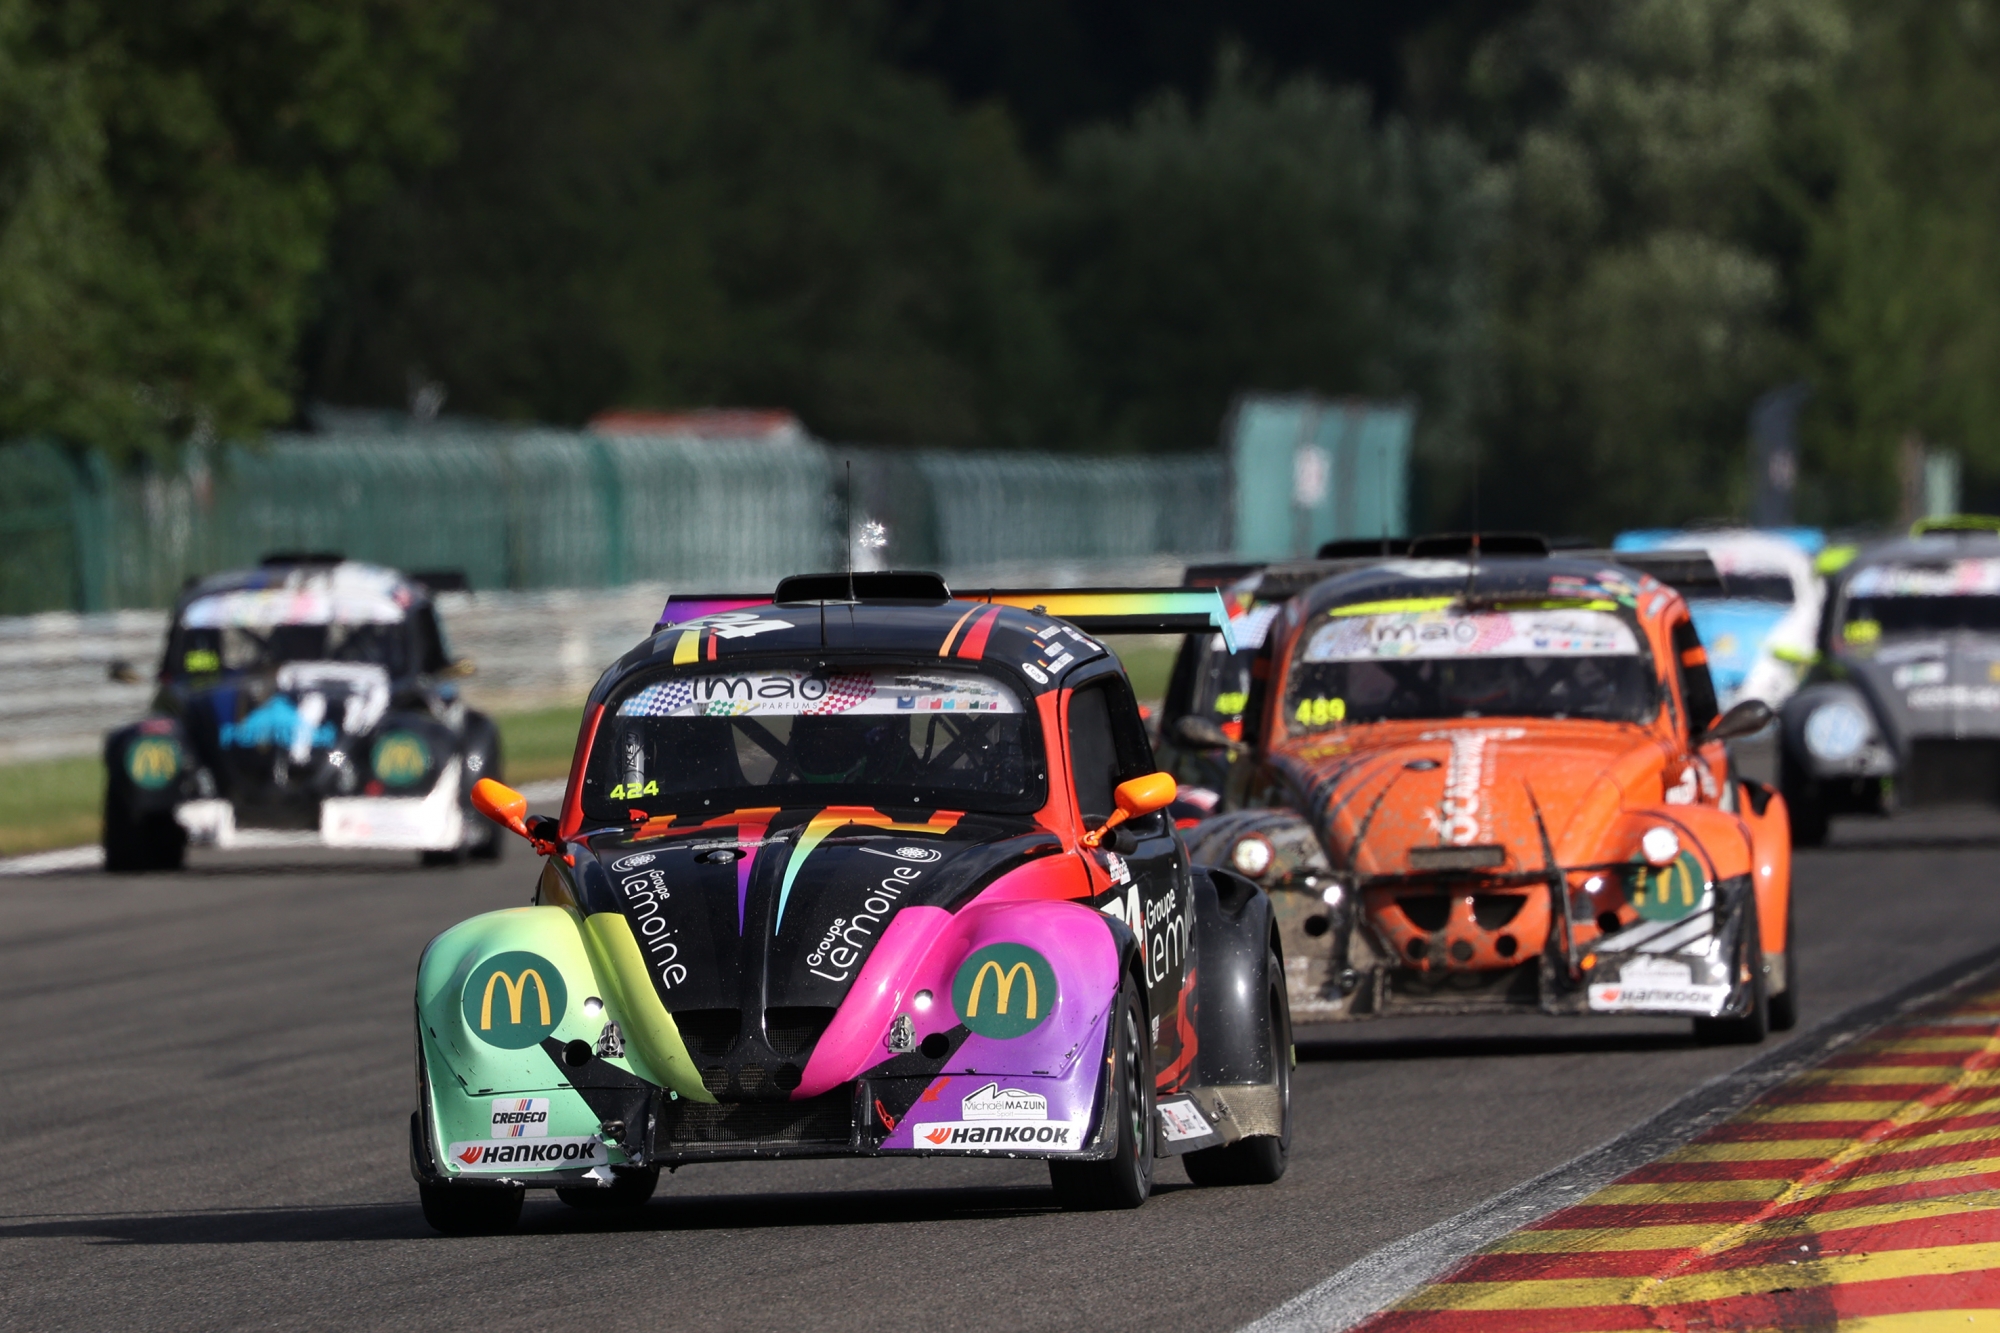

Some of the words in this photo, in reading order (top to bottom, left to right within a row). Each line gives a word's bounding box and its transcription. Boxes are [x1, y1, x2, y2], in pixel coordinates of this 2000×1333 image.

[762, 702, 818, 710] PARFUMS
[1295, 698, 1345, 726] 489
[610, 780, 659, 800] 424
[650, 869, 670, 900] Groupe
[1146, 888, 1176, 930] Groupe
[806, 918, 846, 967] Groupe
[492, 1111, 547, 1124] CREDECO
